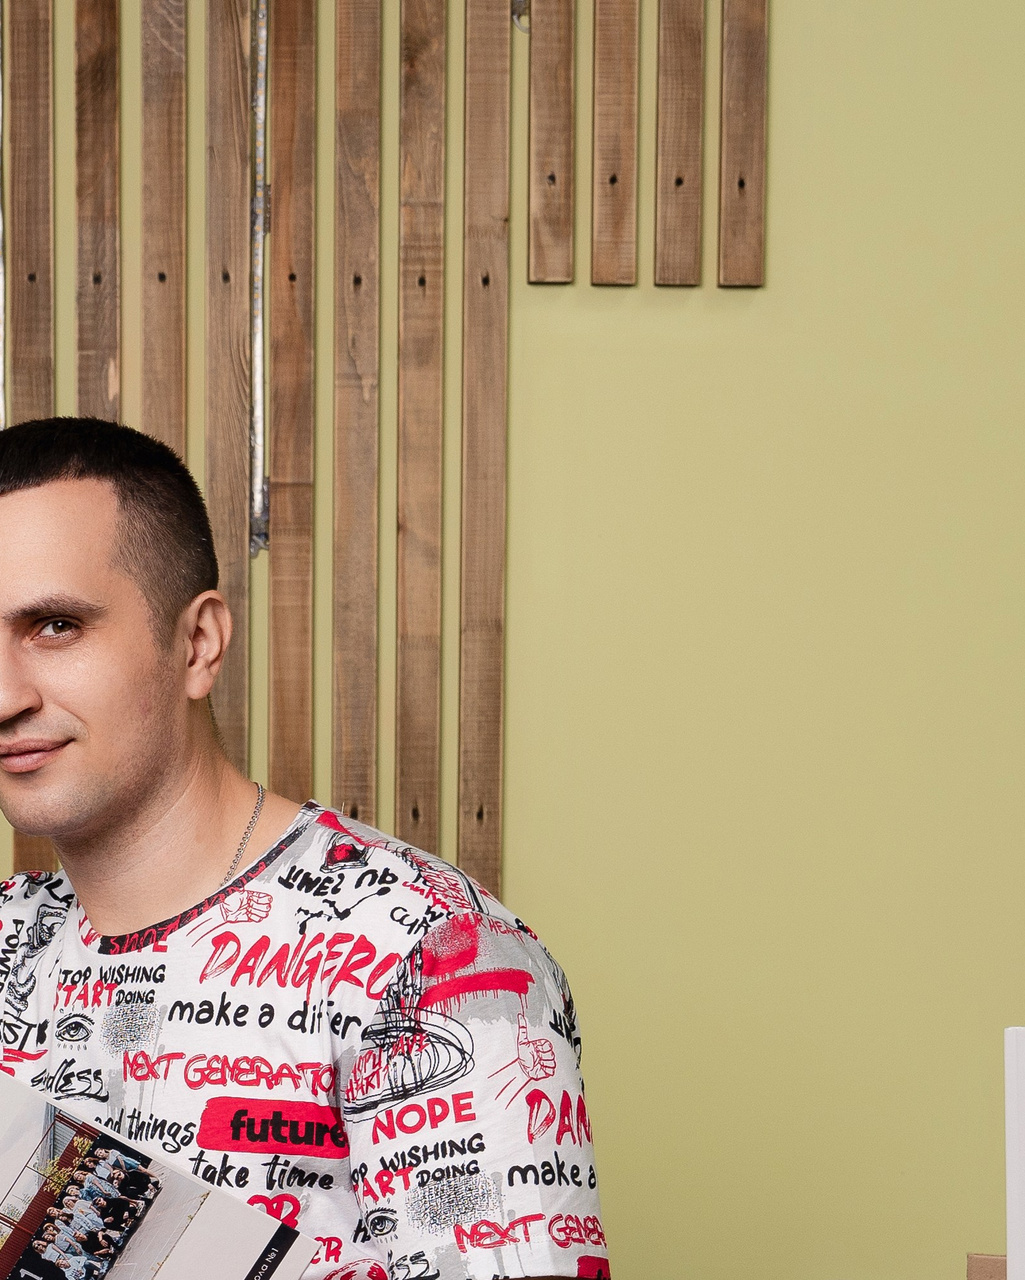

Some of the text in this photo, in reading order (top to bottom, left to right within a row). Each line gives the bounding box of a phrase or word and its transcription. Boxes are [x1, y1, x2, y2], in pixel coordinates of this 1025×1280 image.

[59, 964, 166, 986] TOP WISHING
[116, 989, 156, 1007] DOING
[168, 991, 250, 1028] make
[258, 1001, 275, 1029] a
[123, 1050, 186, 1083] NEXT
[127, 1108, 198, 1154] things
[372, 1091, 477, 1145] NOPE
[189, 1151, 335, 1191] take time
[380, 1132, 486, 1173] WISHING
[507, 1151, 582, 1188] make
[415, 1160, 481, 1188] DOING
[453, 1213, 546, 1253] NEXT
[265, 1247, 279, 1264] №1
